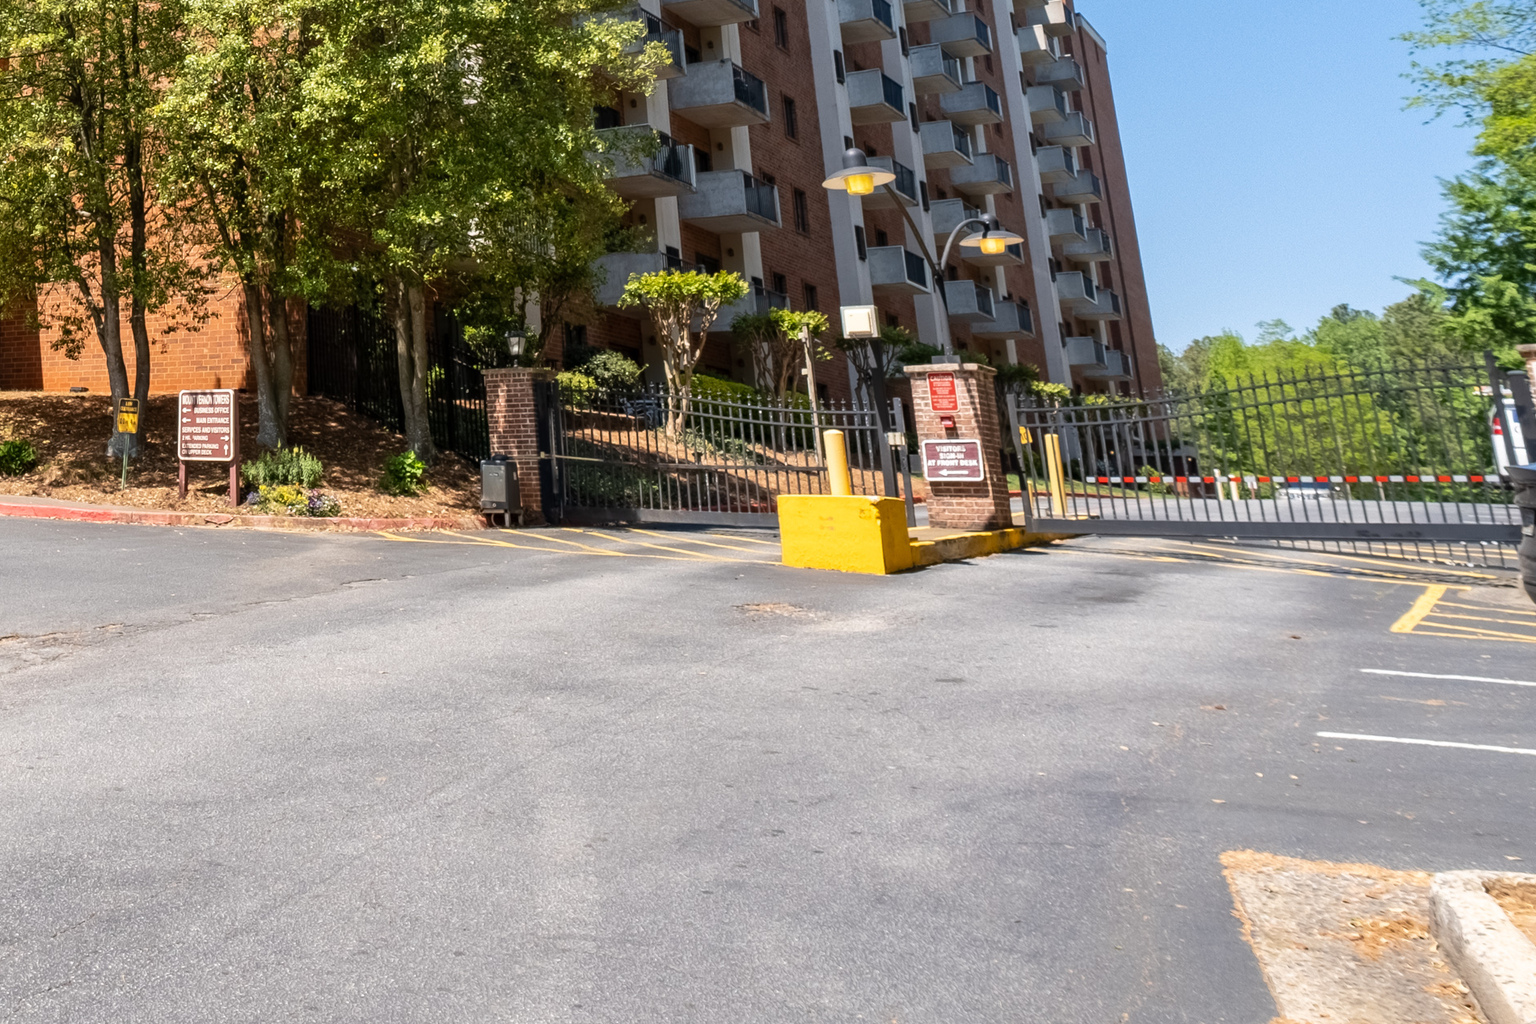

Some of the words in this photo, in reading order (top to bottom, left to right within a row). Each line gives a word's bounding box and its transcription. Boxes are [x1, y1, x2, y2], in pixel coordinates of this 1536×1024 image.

[182, 394, 196, 404] MOUNT
[196, 394, 212, 404] VERNON
[213, 394, 229, 404] TOWERS
